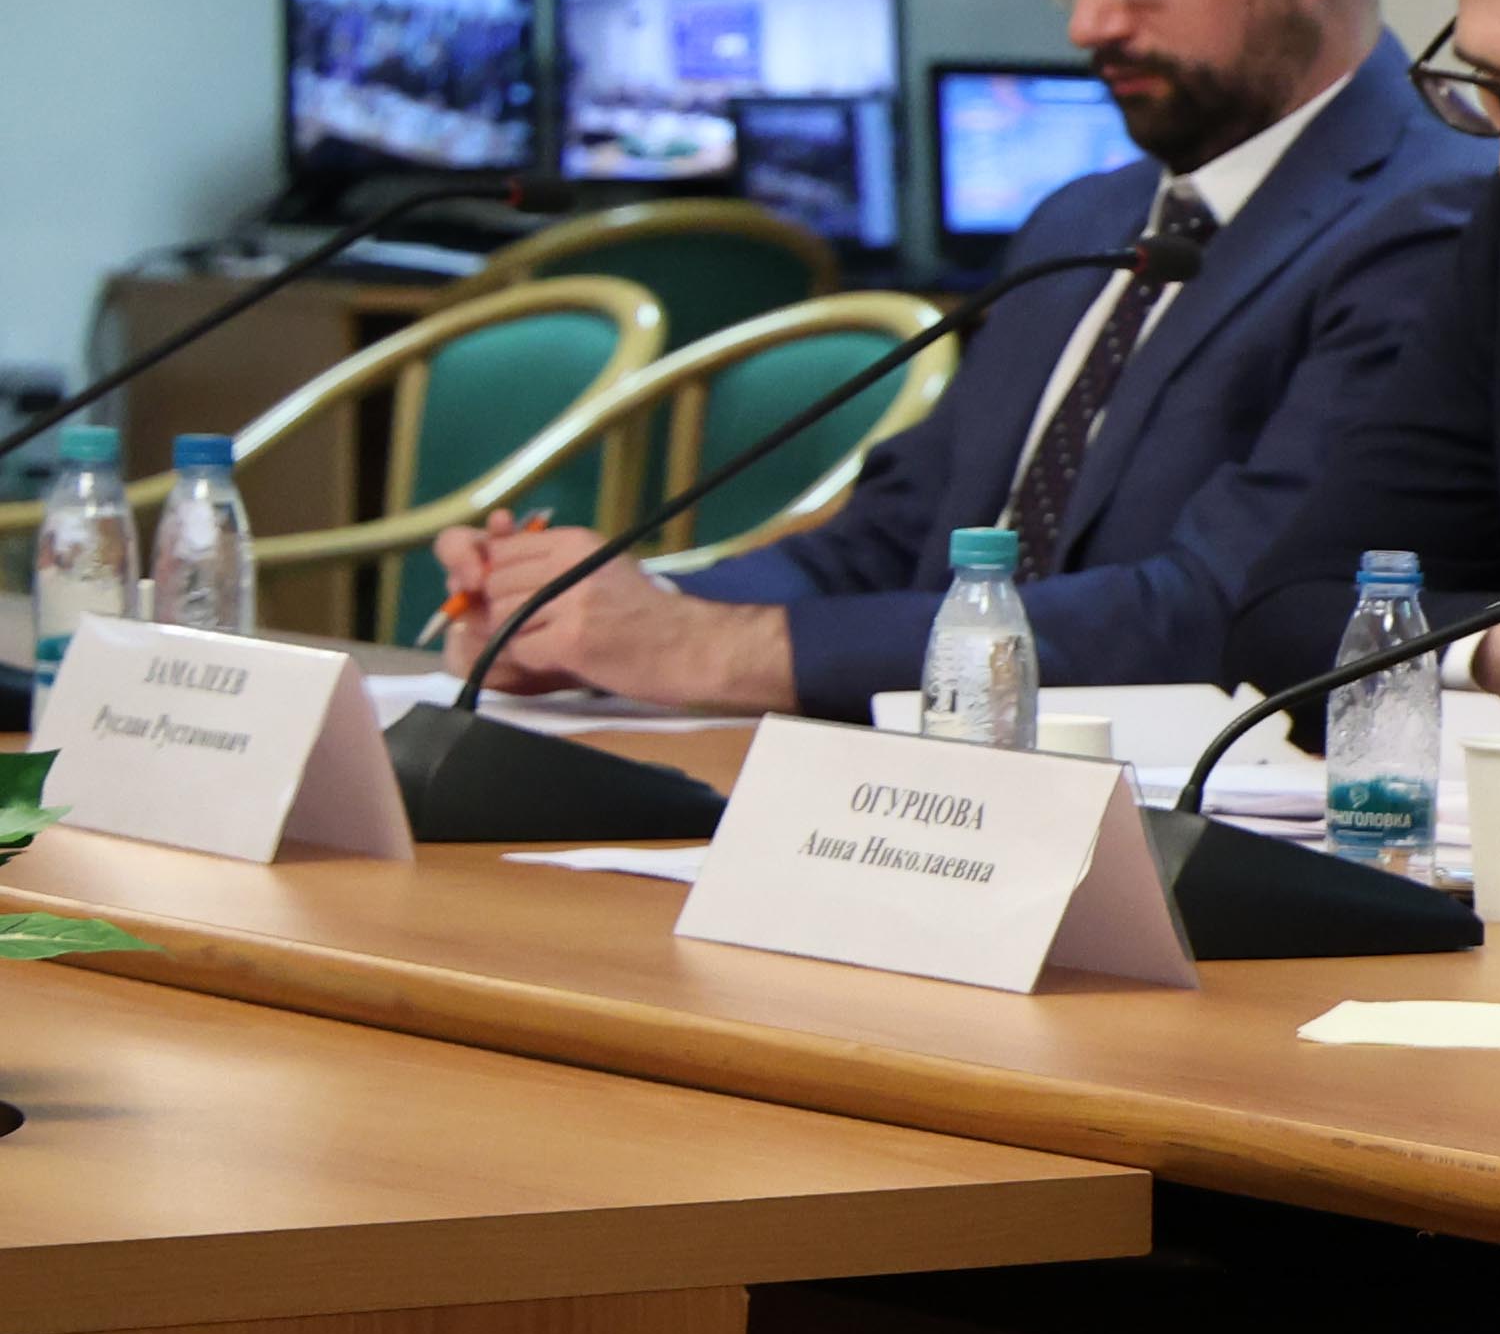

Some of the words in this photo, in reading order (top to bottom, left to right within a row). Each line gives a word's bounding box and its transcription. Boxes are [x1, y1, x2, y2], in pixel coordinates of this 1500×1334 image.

[849, 782, 985, 831] ОГУРЦОВА
[798, 828, 857, 862] Анна
[858, 834, 996, 885] Николаевна
